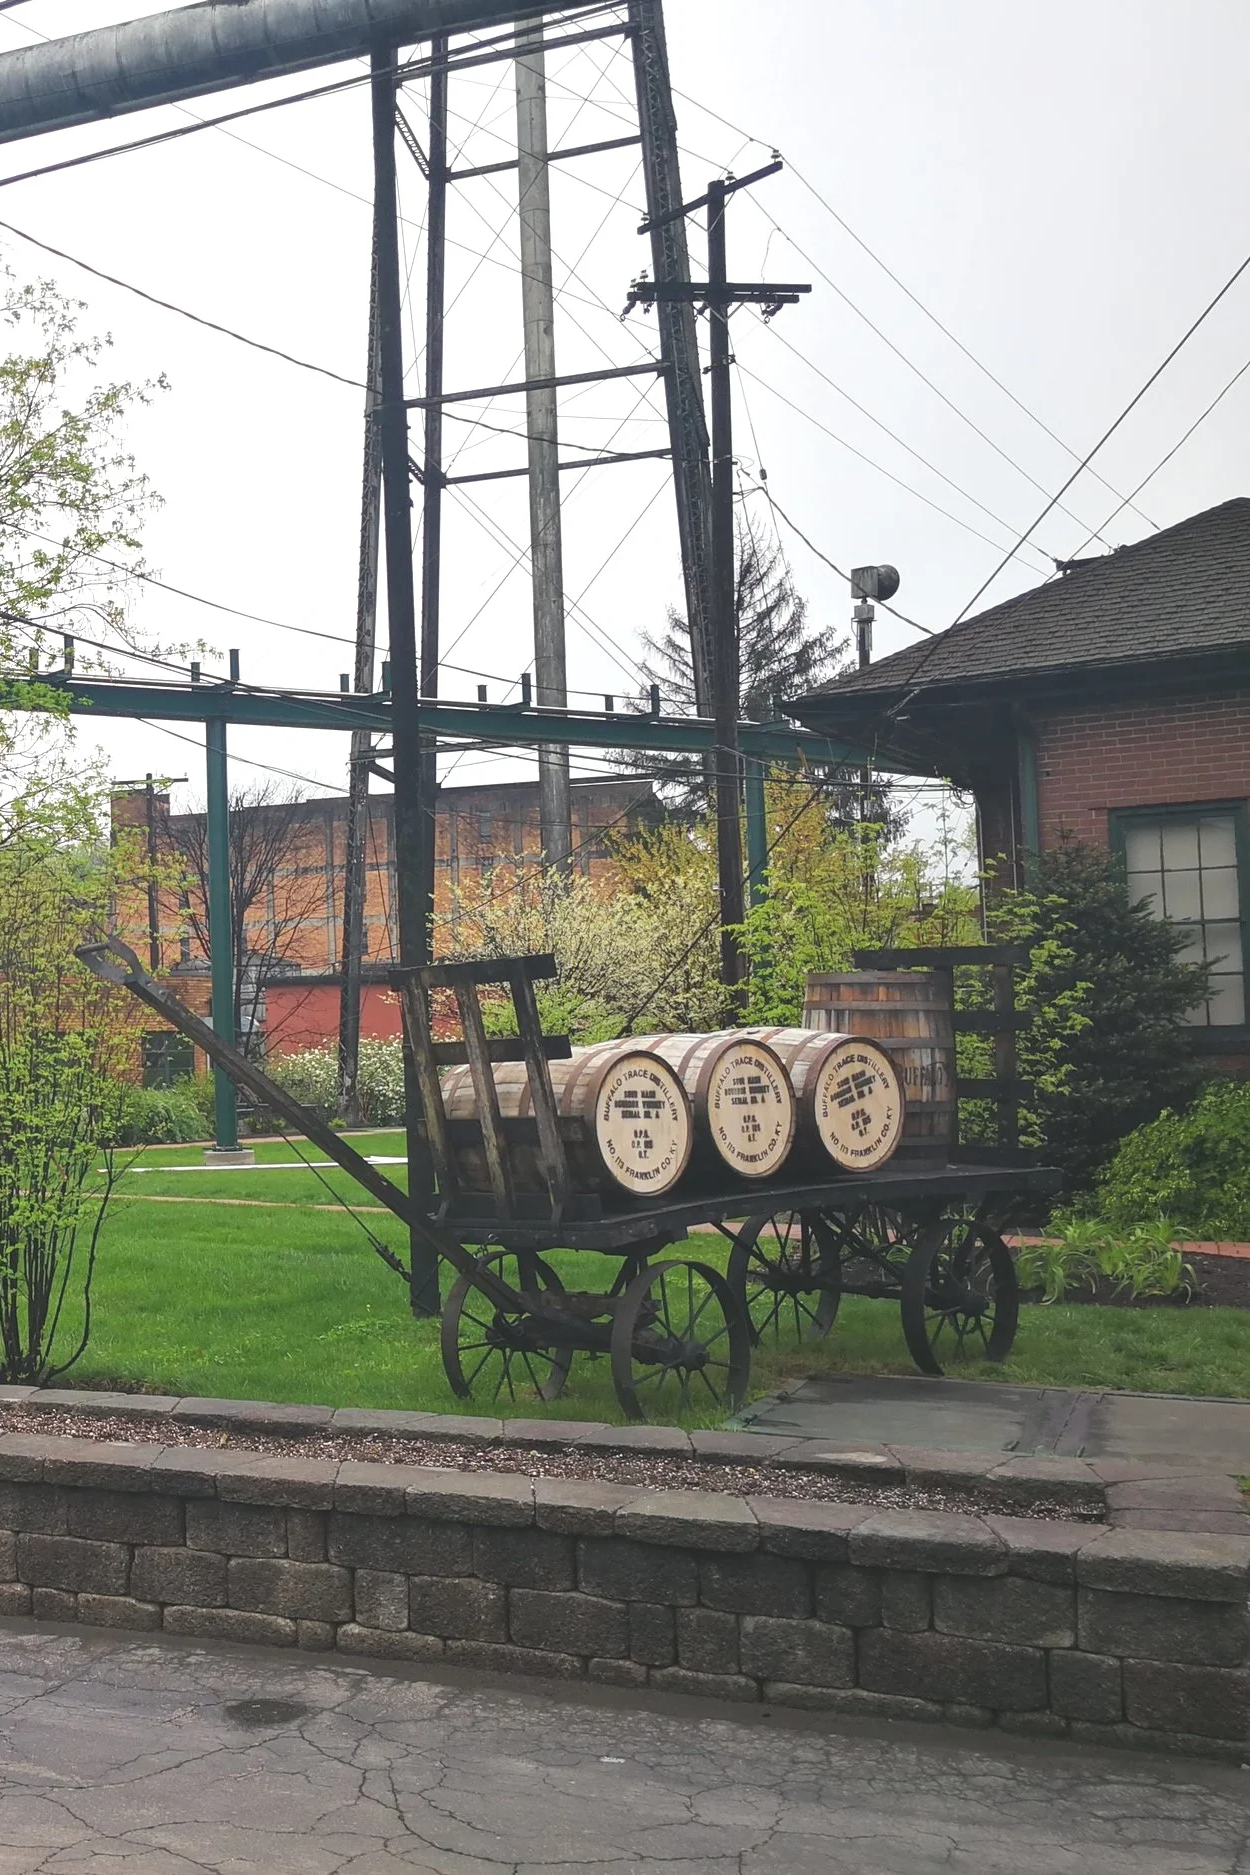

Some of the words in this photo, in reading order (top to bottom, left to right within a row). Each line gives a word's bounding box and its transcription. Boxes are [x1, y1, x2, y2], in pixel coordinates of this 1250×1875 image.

[603, 1078, 623, 1122] BUFFALO
[623, 1069, 648, 1081] TRACE
[649, 1073, 678, 1122] DISTILLERY
[714, 1066, 731, 1109] BUFFALO
[730, 1056, 753, 1069] TRACE
[753, 1058, 782, 1104] DISTILLERY
[822, 1073, 834, 1118] BUFFALO
[833, 1054, 855, 1074] TRACE
[857, 1054, 890, 1089] DISTILLERY
[736, 1149, 769, 1163] FRANKLIN
[850, 1137, 882, 1158] FRANKLIN
[625, 1166, 660, 1180] FRANKLIN
